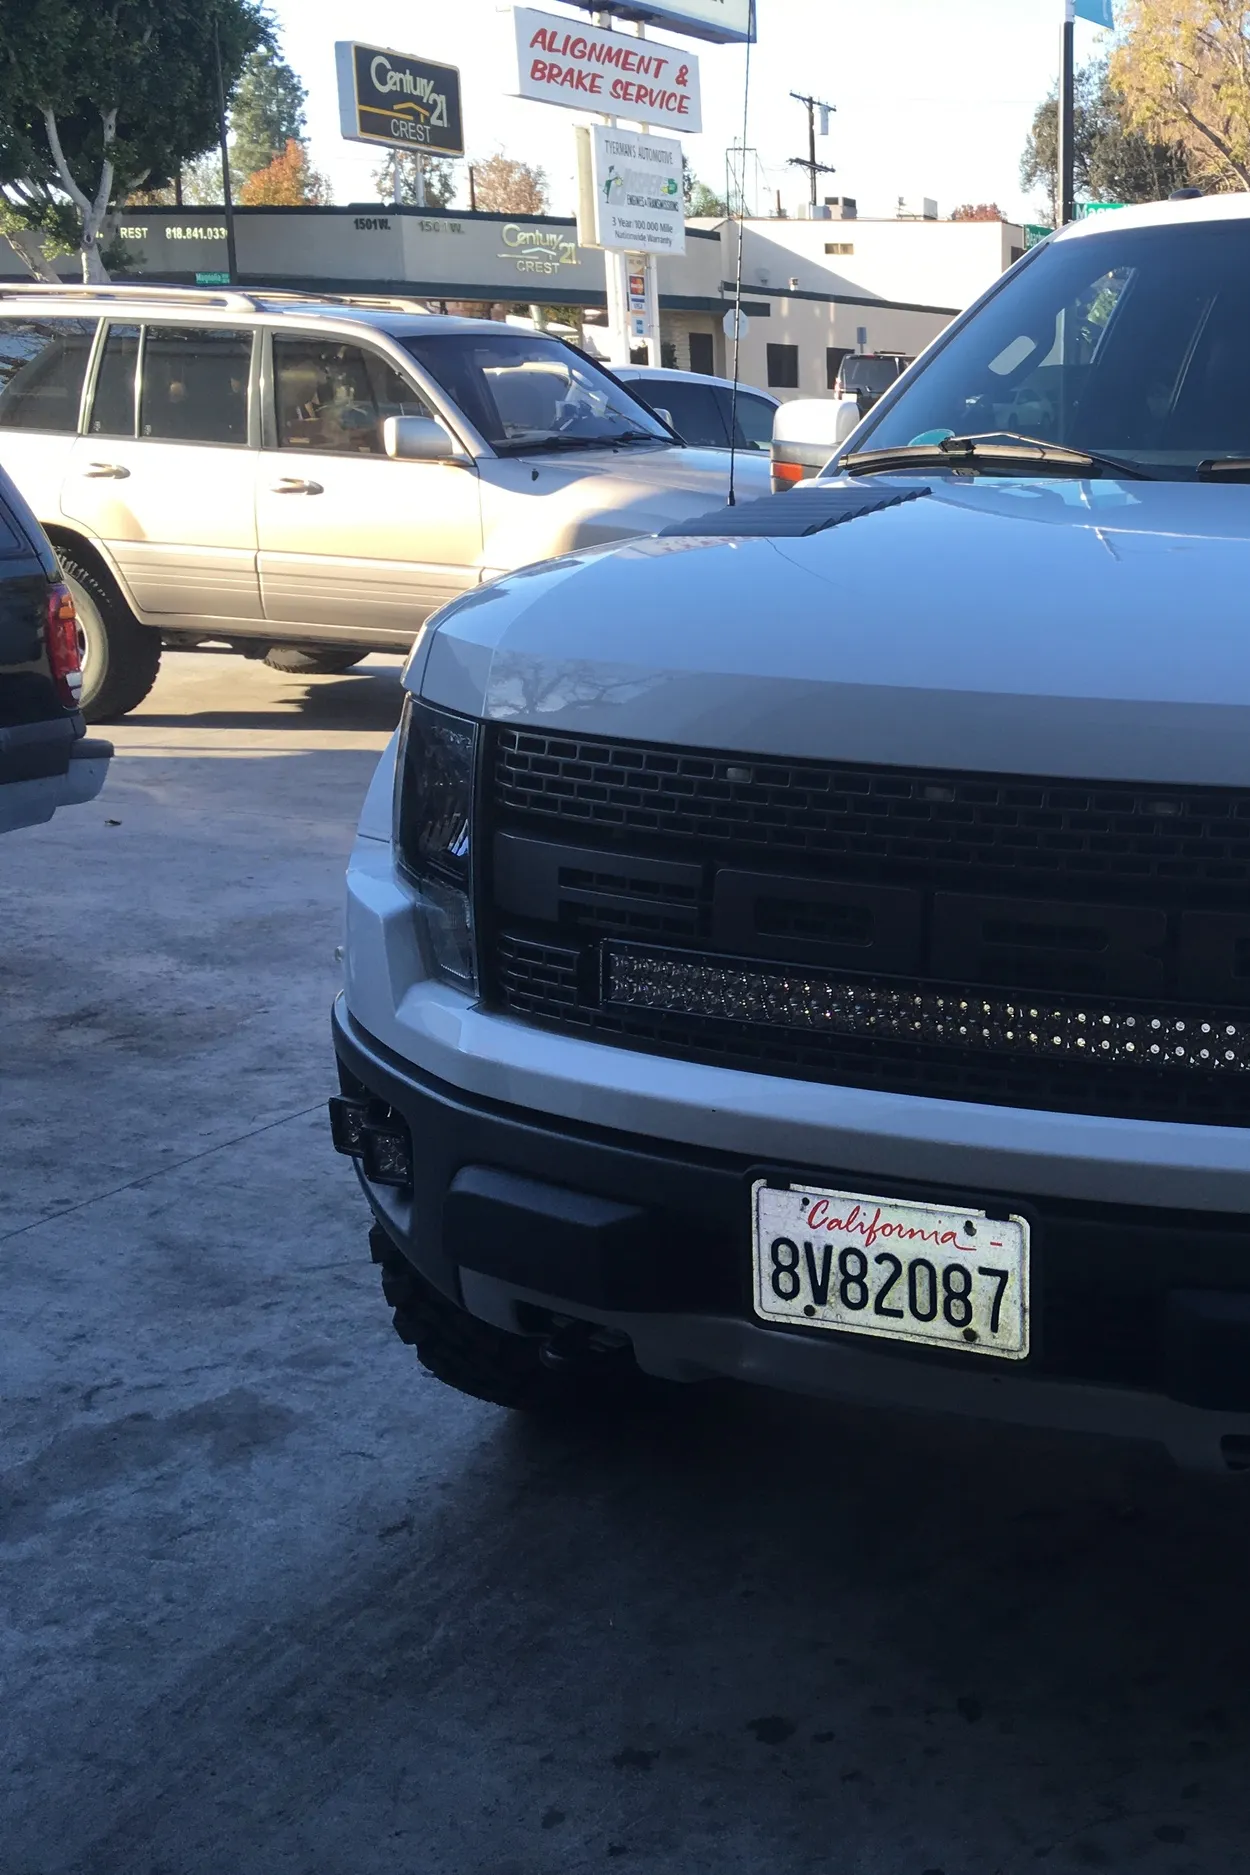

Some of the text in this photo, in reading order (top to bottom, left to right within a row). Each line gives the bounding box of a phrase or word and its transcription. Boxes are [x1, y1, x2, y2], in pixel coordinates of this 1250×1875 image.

[529, 28, 689, 87] ALIGNMENT &
[370, 55, 448, 128] Century 21
[530, 59, 692, 115] BRAKE SERVICE
[390, 118, 431, 142] CREST
[638, 146, 674, 165] AUTOMOTIVE
[165, 227, 228, 239] 818.841.033
[354, 218, 377, 230] 1501
[612, 216, 617, 227] 3
[659, 222, 673, 234] Mile
[502, 223, 564, 250] Century
[614, 229, 672, 248] Nationwide Warranty
[516, 260, 560, 274] CREST
[807, 1199, 977, 1251] California
[770, 1236, 1009, 1334] 8V82087
